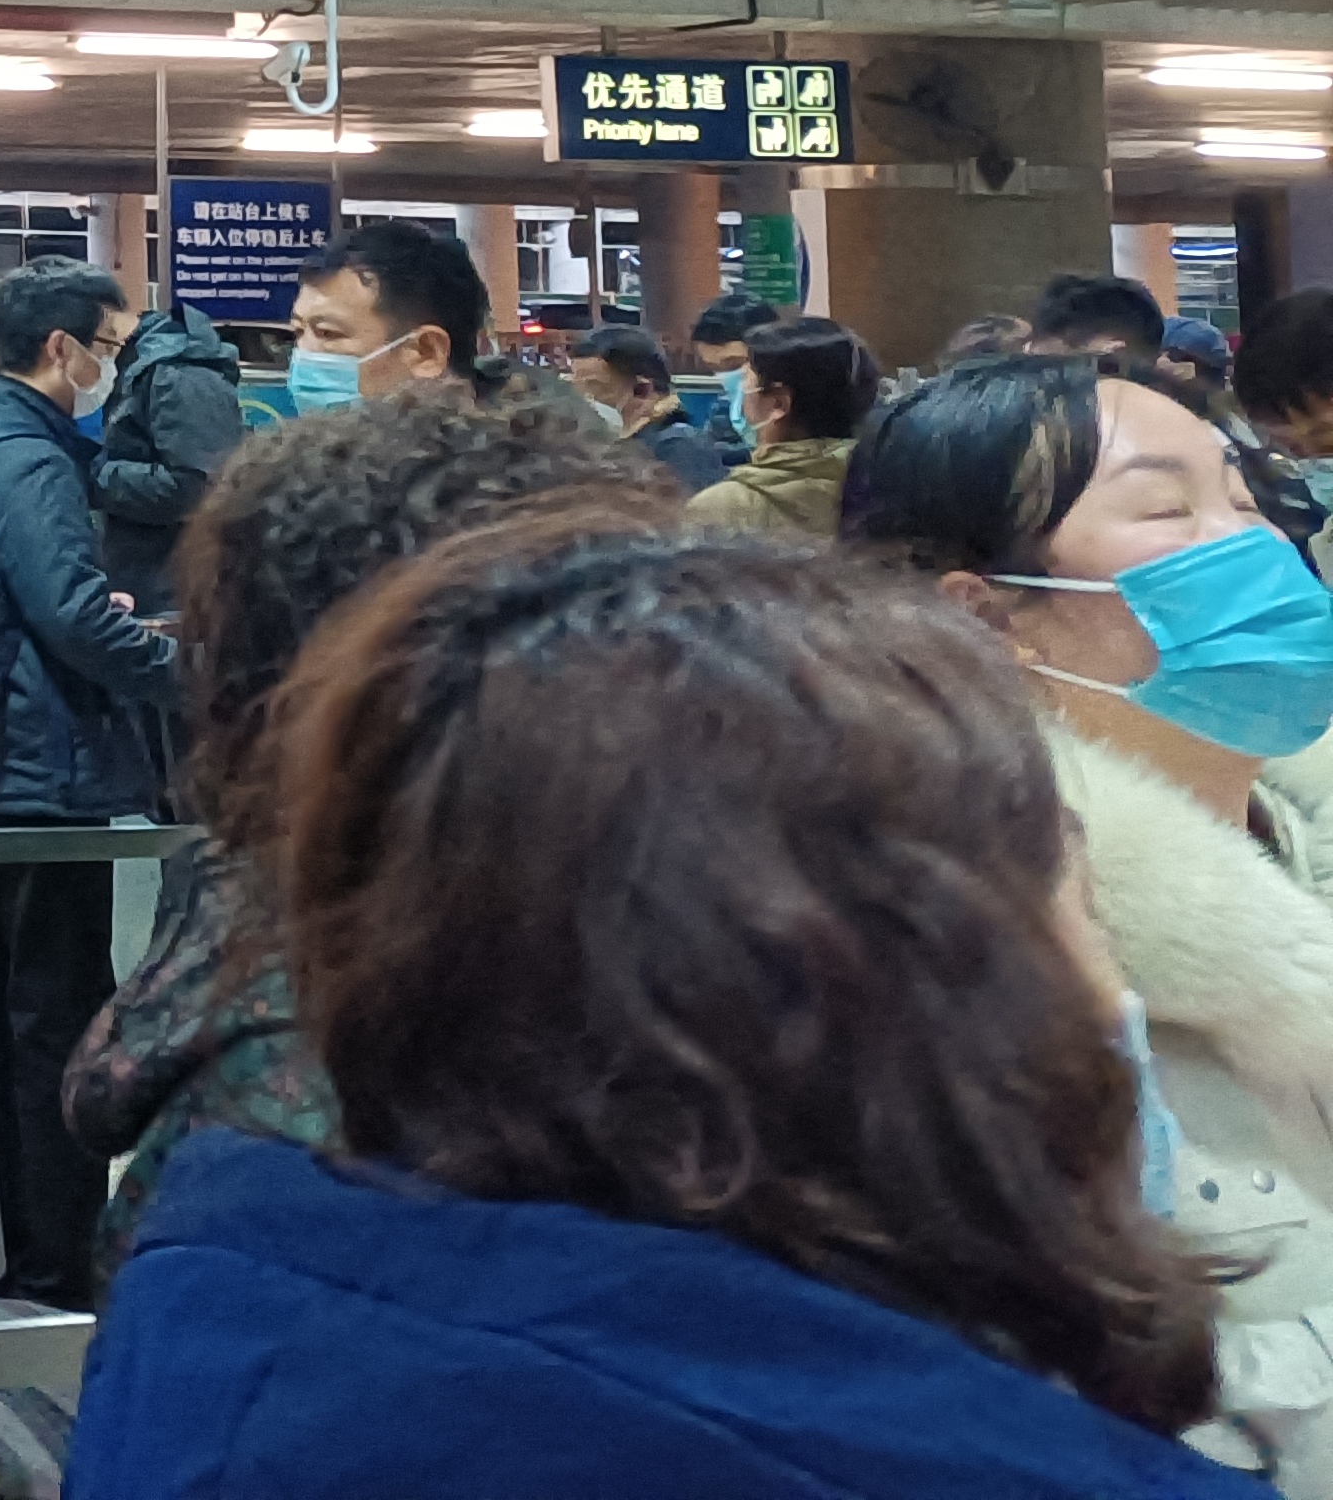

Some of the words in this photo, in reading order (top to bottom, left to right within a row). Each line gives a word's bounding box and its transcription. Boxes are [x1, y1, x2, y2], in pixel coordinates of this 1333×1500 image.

[582, 72, 726, 111] 优先通道
[583, 118, 653, 146] Priority
[655, 119, 700, 142] lane
